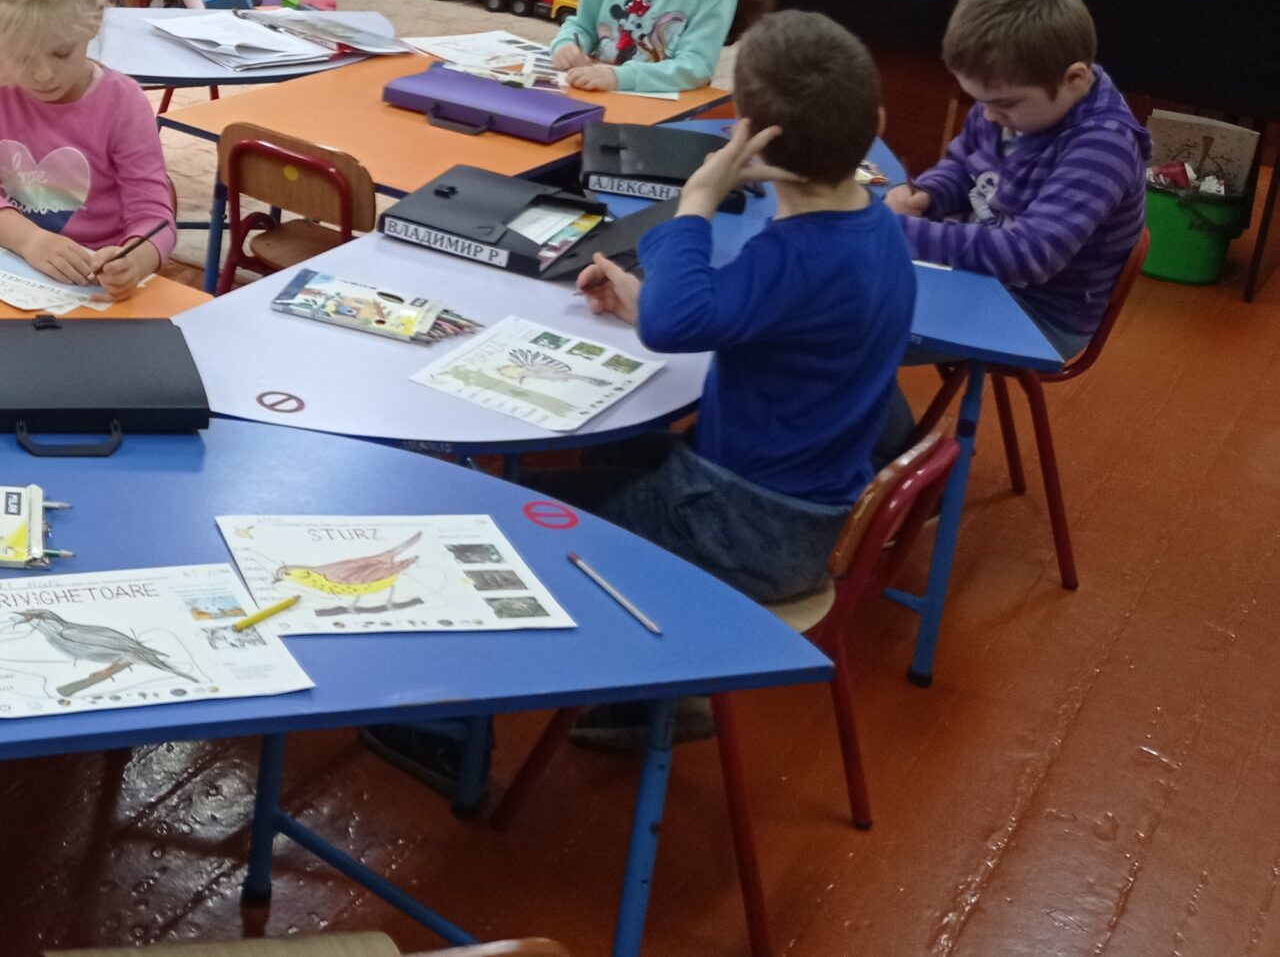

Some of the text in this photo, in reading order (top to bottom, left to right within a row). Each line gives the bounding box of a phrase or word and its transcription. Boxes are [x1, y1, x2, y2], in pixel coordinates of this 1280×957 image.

[590, 175, 680, 200] АЛЕКСАН
[386, 219, 503, 265] ВЛАДИМИР Р.
[307, 526, 386, 543] STURZ
